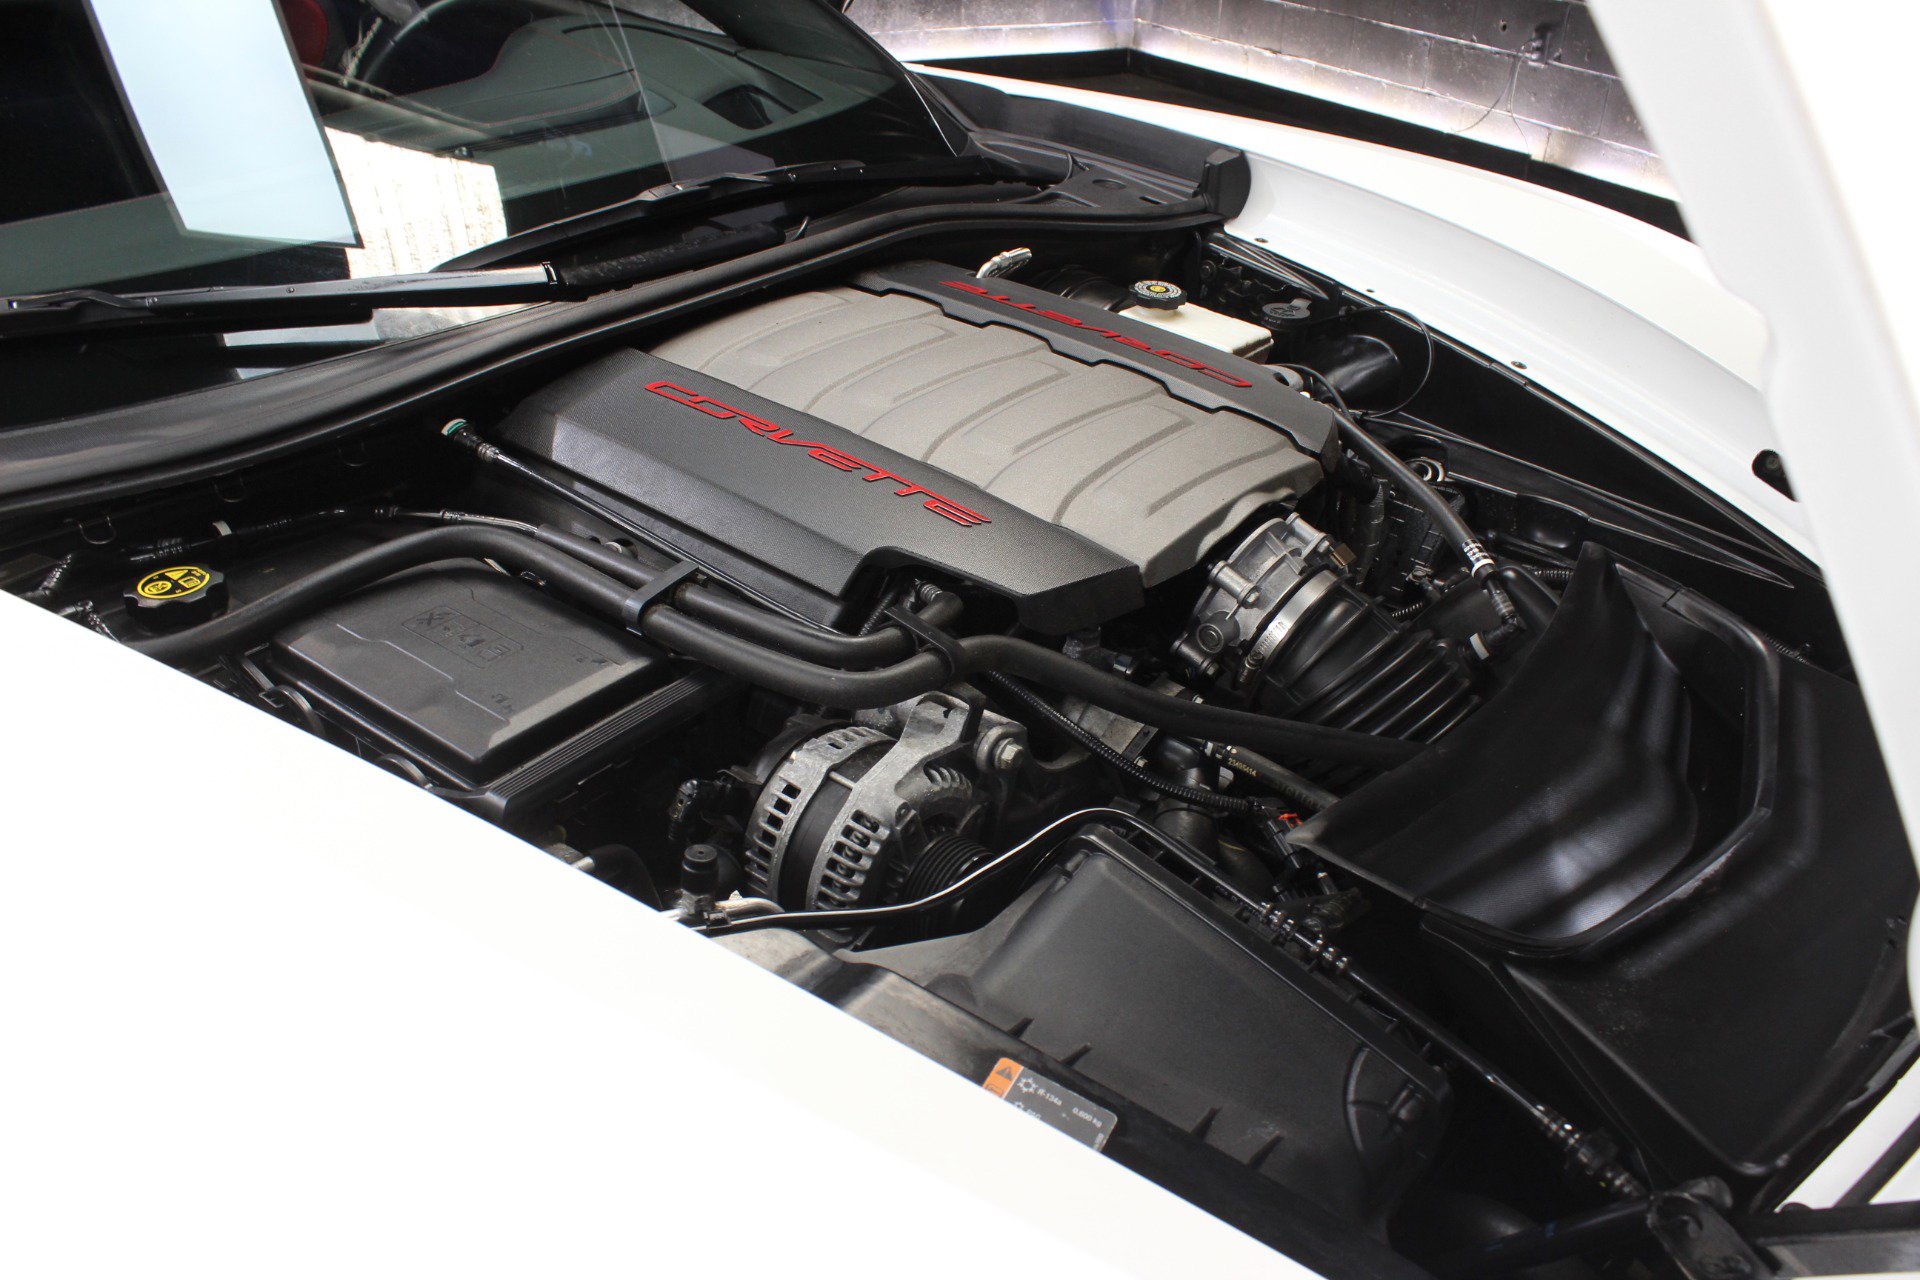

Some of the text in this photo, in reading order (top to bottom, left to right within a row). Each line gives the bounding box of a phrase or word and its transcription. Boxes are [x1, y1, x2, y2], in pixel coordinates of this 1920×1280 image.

[939, 281, 1252, 388] CORVETTE
[644, 381, 992, 527] CORVETTE
[1037, 1088, 1062, 1106] R-134a
